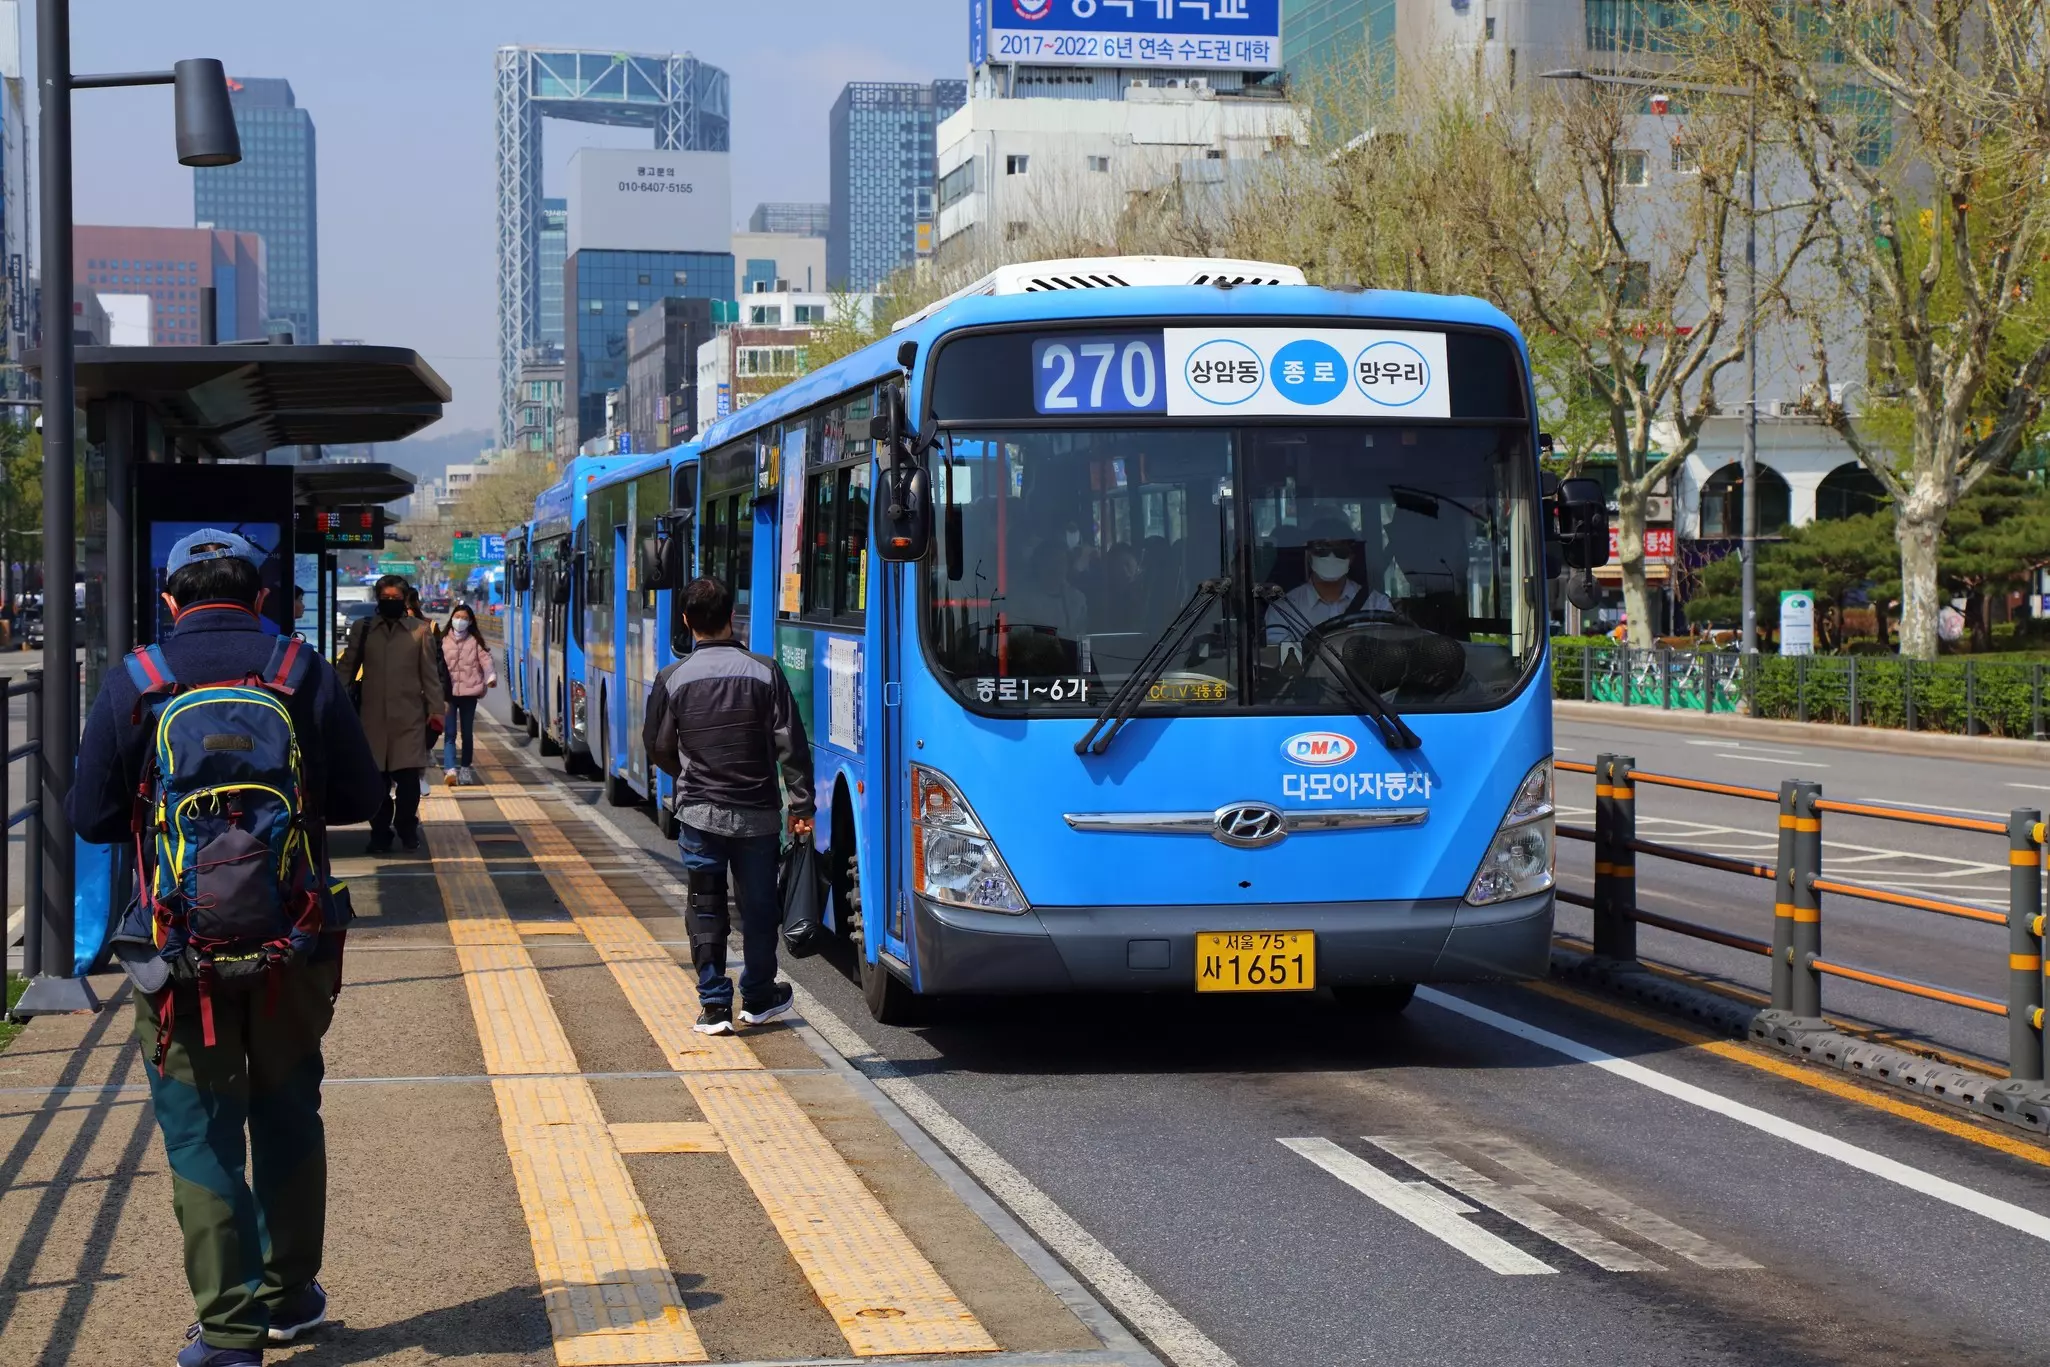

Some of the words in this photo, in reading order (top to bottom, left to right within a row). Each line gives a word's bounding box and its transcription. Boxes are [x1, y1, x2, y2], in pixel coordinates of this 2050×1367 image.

[1000, 35, 1098, 57] 2017~2022
[1104, 38, 1132, 59] 6년
[1139, 38, 1174, 60] 연속
[1179, 39, 1231, 61] 수도권
[1236, 40, 1270, 63] 대학
[618, 182, 693, 193] 010-6407-5155
[1041, 340, 1157, 409] 270
[1190, 360, 1259, 385] 상암동
[1359, 360, 1425, 386] 망우리
[1150, 684, 1188, 699] CCTV
[1296, 740, 1342, 755] DMA
[1282, 771, 1433, 802] 다모아자동차
[1226, 935, 1253, 950] 서울
[1260, 934, 1285, 949] 75
